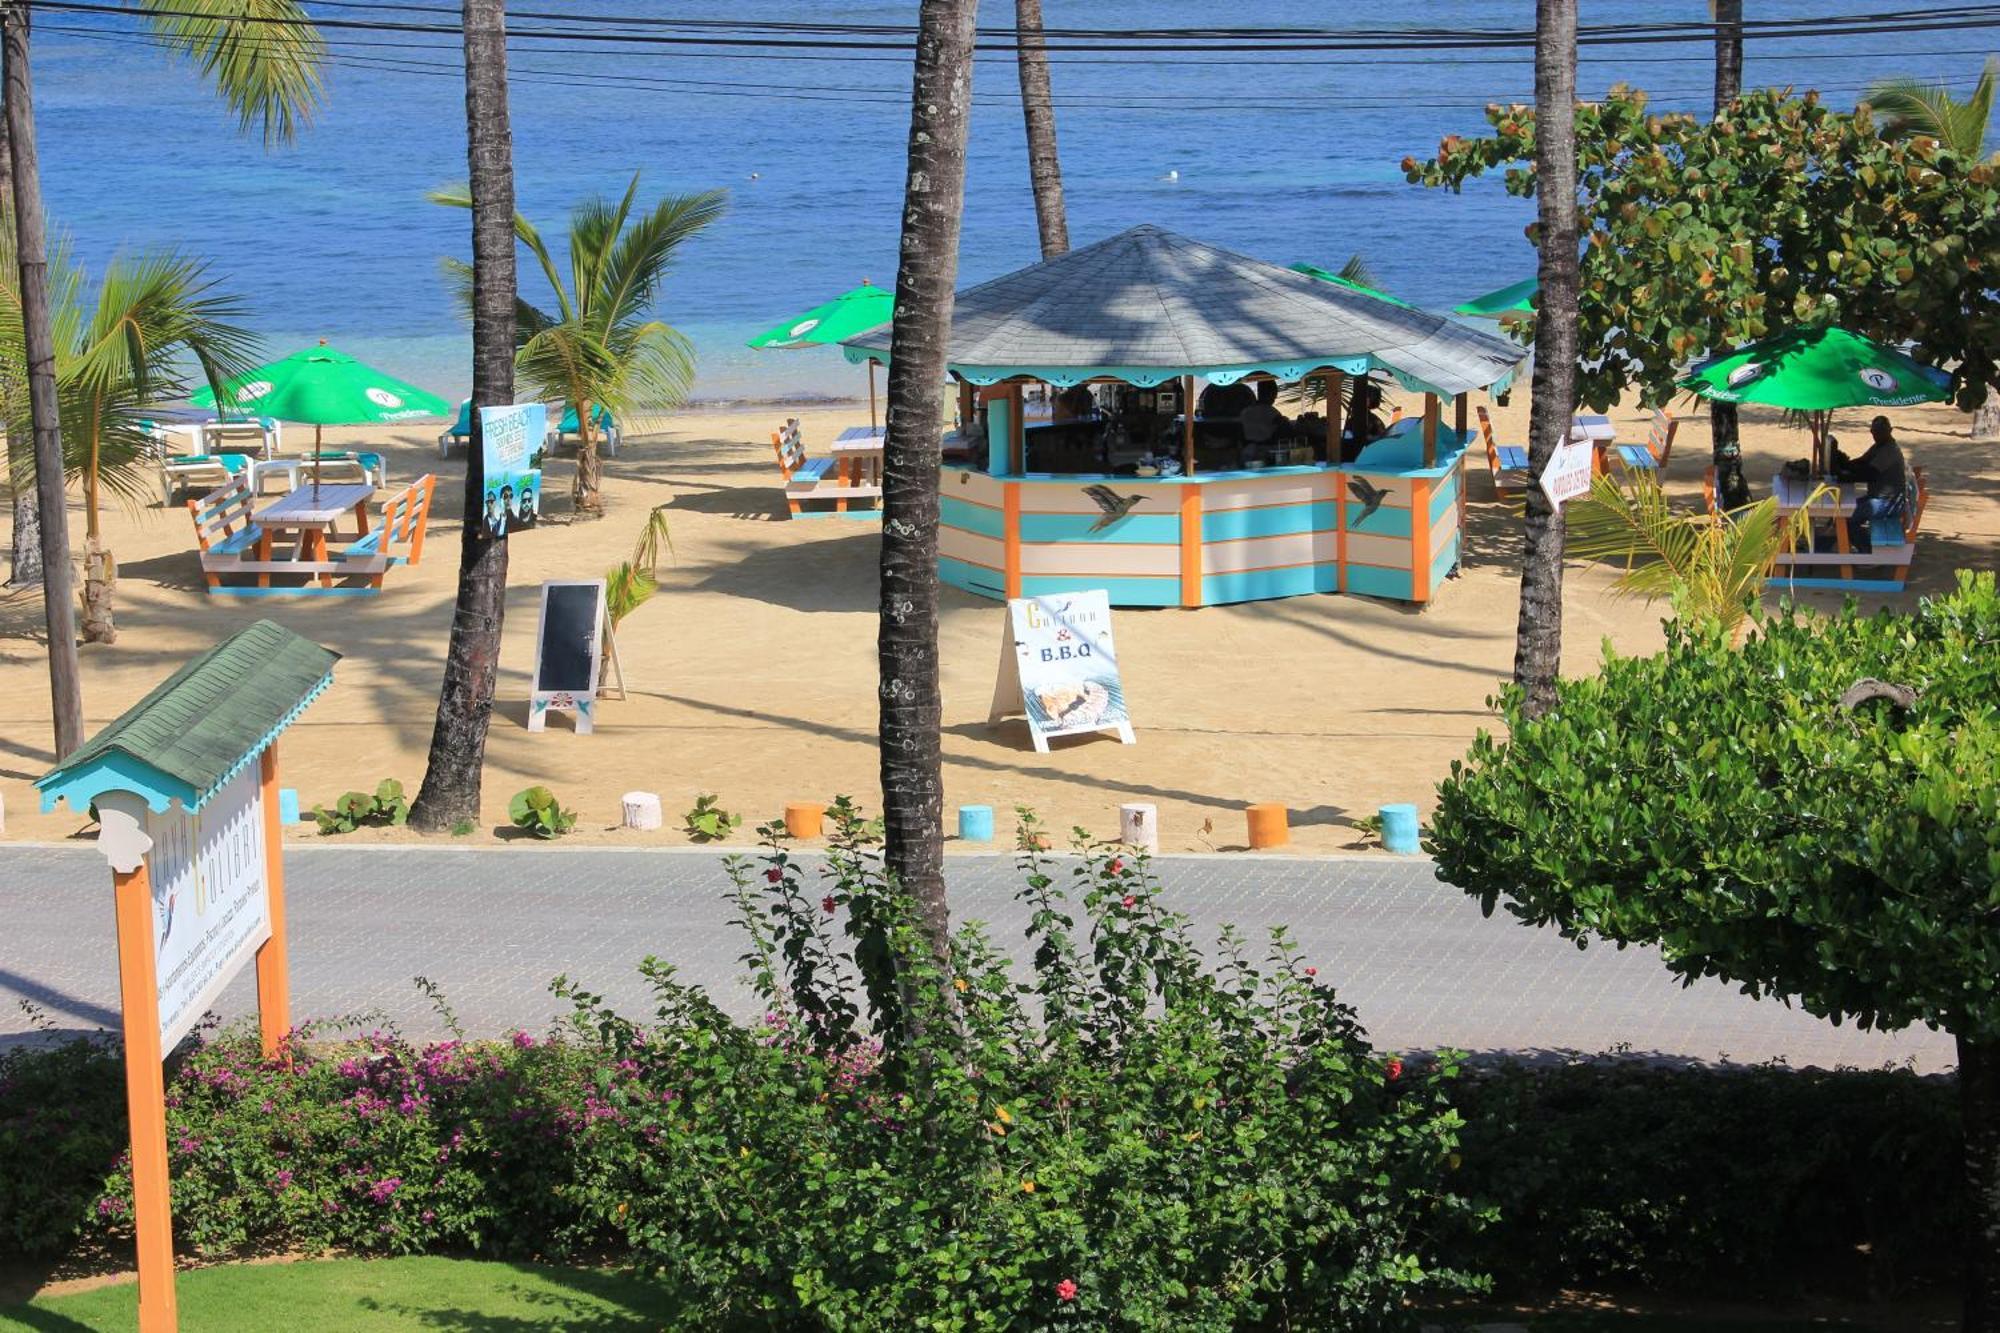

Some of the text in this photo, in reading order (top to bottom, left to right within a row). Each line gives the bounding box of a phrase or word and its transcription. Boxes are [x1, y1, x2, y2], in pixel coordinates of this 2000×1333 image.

[1868, 393, 1927, 406] Presidente
[1040, 643, 1091, 662] B.B.Q
[154, 814, 188, 888] LAYA
